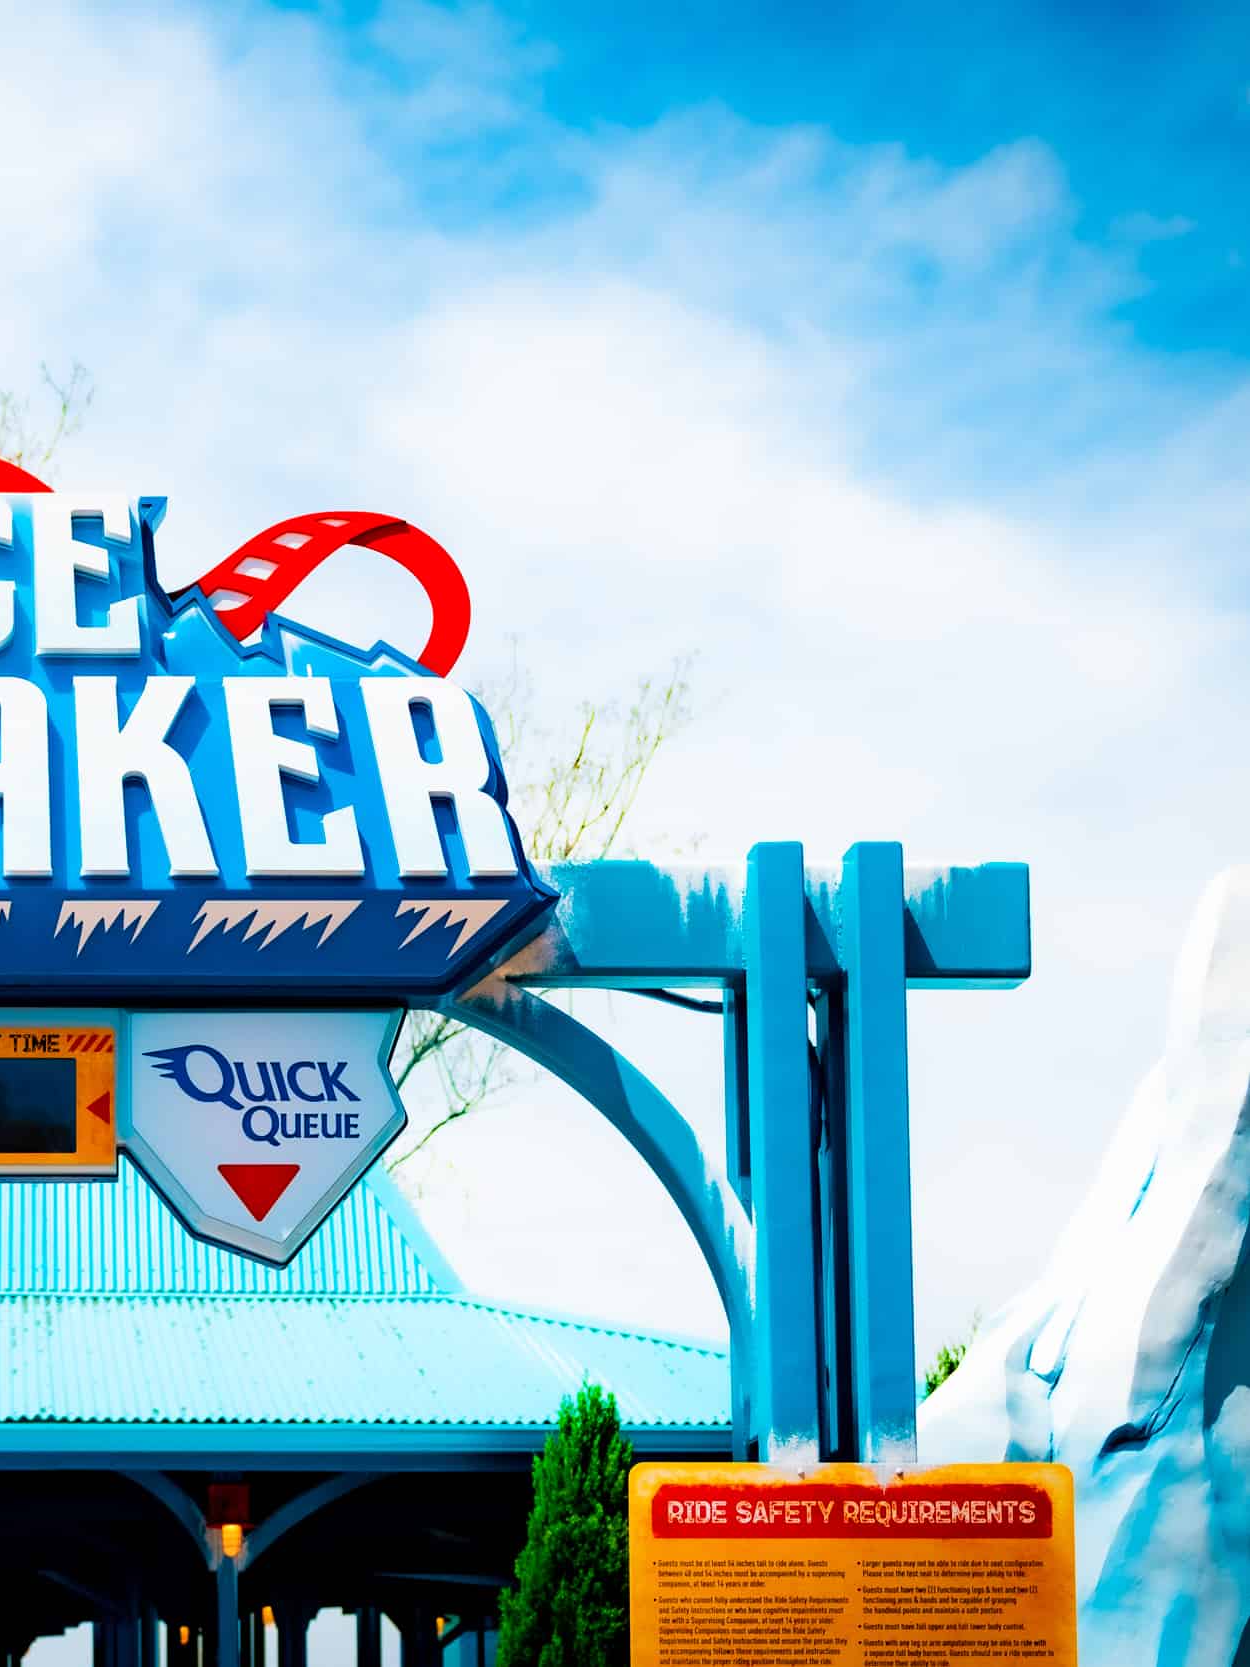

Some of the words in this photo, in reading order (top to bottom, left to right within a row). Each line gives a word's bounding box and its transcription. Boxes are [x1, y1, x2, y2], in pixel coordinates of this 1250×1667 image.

[9, 1033, 61, 1053] TIME
[142, 1044, 361, 1110] QUICK
[242, 1105, 360, 1147] QUEUE
[667, 1500, 727, 1524] RIDE
[735, 1500, 835, 1524] SAFETY
[843, 1500, 1036, 1528] REQUIREMENTS
